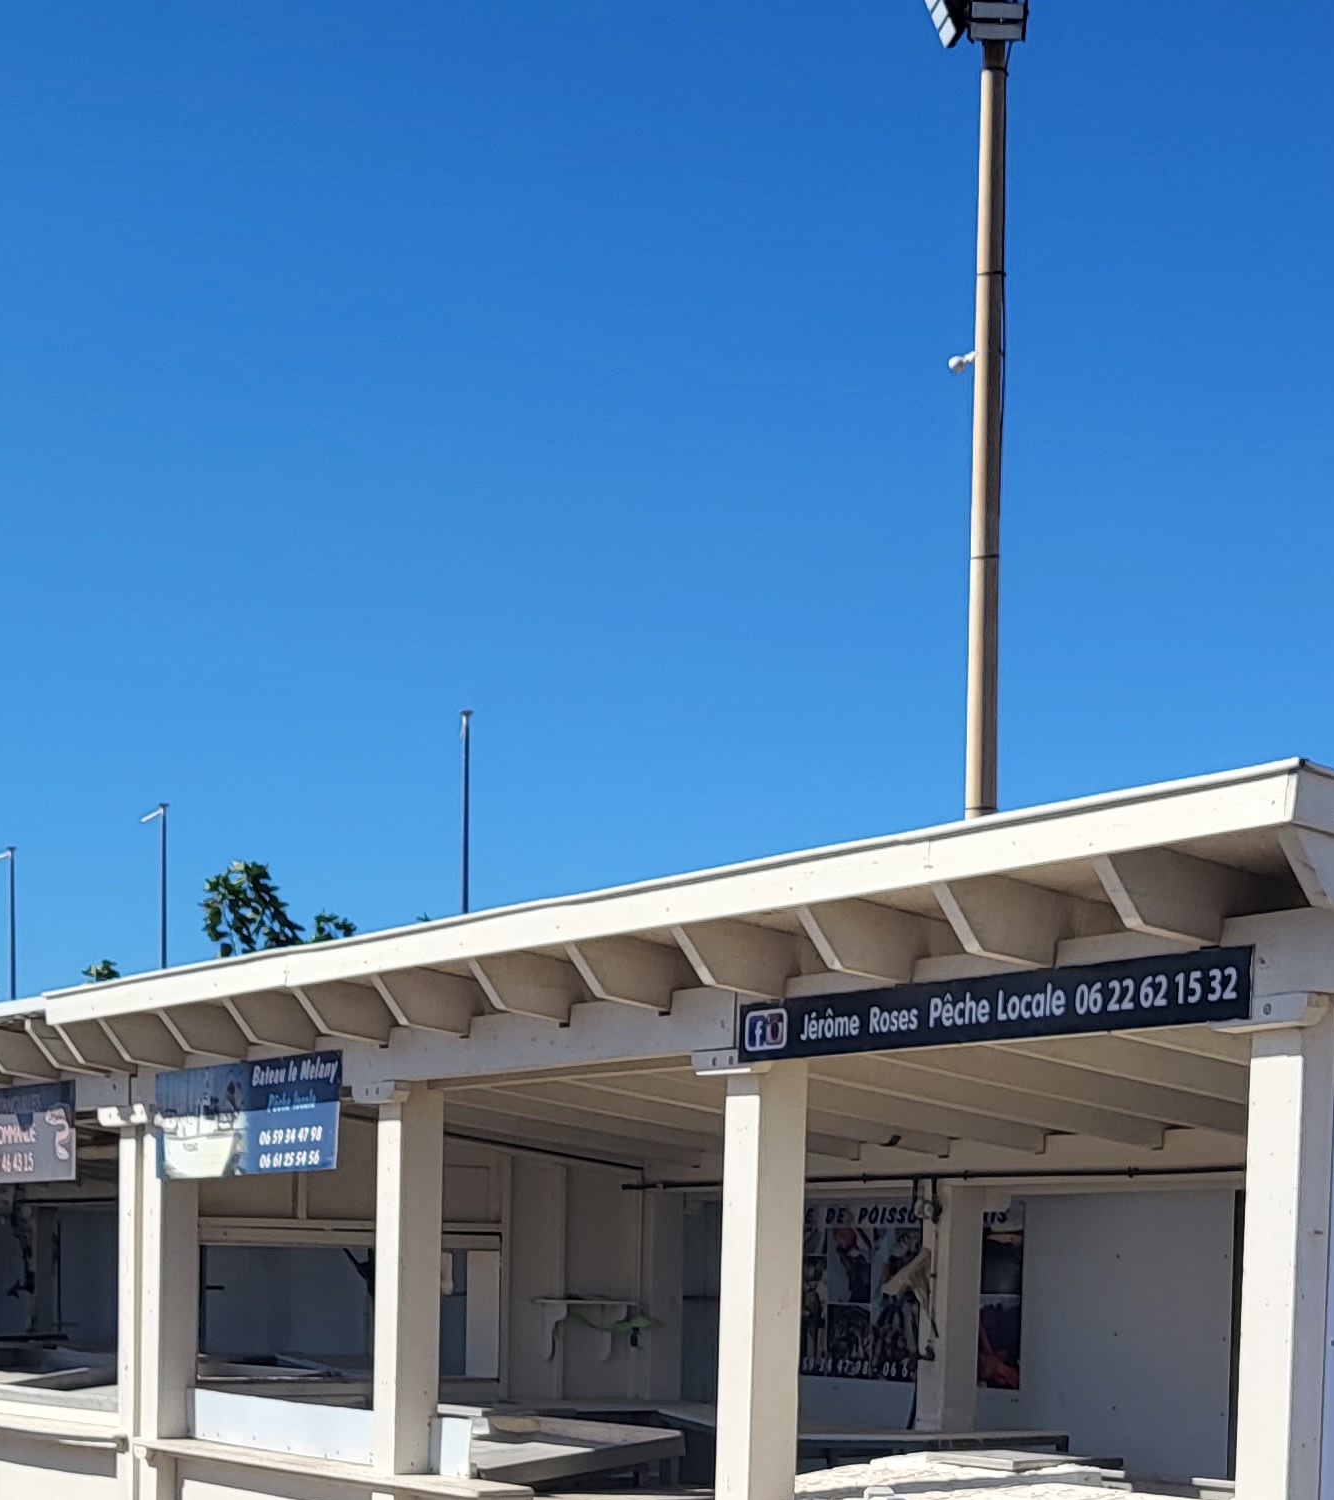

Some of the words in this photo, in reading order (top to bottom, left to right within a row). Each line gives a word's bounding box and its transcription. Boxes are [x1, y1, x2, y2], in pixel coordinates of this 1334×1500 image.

[799, 1006, 860, 1041] Jérôme
[868, 1005, 919, 1034] Roses
[928, 992, 991, 1029] Pêche
[996, 981, 1066, 1021] Locale
[1074, 981, 1103, 1015] 06
[1106, 978, 1135, 1012] 22
[1139, 974, 1168, 1009] 62
[1174, 970, 1203, 1005] 15
[1207, 966, 1238, 1001] 32
[251, 1064, 286, 1087] Bateau
[287, 1059, 298, 1083] le
[259, 1131, 271, 1146] 06
[272, 1129, 284, 1145] 59
[285, 1128, 296, 1144] 34
[298, 1127, 310, 1142] 47
[311, 1125, 323, 1141] 98
[23, 1151, 34, 1172] 15
[259, 1153, 271, 1169] 06
[272, 1152, 283, 1168] 61
[283, 1151, 294, 1167] 25
[295, 1150, 307, 1166] 54
[308, 1149, 320, 1165] 56
[825, 1207, 847, 1224] DE
[857, 1206, 918, 1224] POISSO
